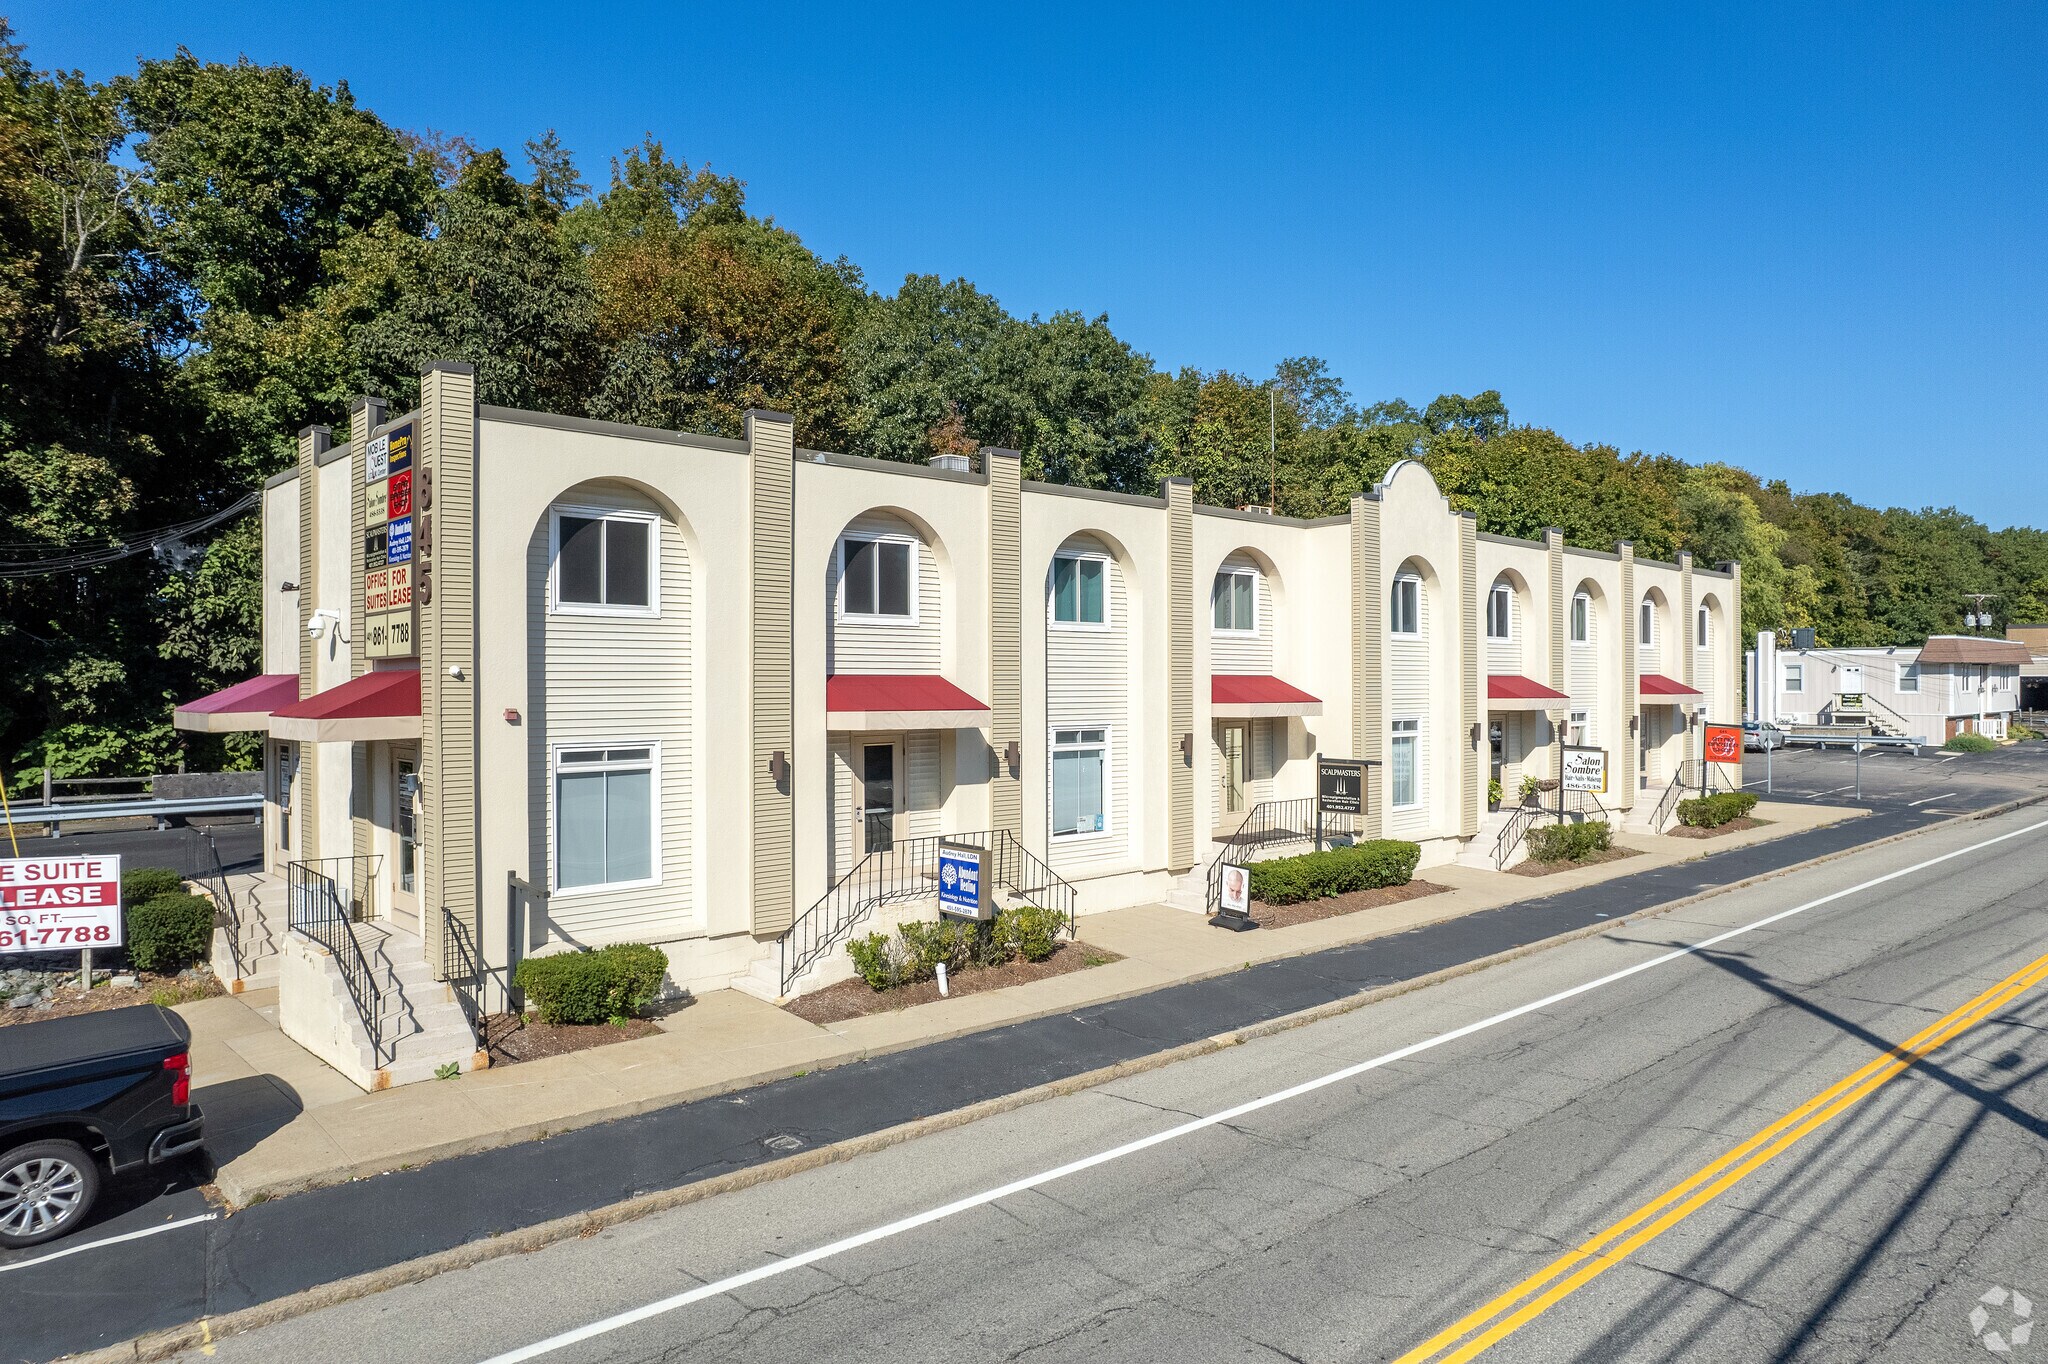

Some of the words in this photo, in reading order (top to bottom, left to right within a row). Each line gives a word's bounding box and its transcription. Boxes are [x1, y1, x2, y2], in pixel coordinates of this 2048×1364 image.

[368, 439, 386, 456] MOBILE
[367, 572, 387, 590] OFFICE
[392, 568, 407, 586] FOR
[367, 592, 387, 610] SUITES
[388, 587, 411, 606] LEASE
[391, 622, 409, 644] 7788
[1575, 753, 1600, 766] Salon
[1321, 768, 1361, 777] SCALPMASTERS
[942, 849, 957, 858] Audrey
[24, 862, 102, 881] SUITE
[958, 865, 978, 881] Abundant
[0, 886, 102, 907] LEASE
[963, 896, 978, 904] Nutrition
[6, 915, 35, 926] SQ.
[40, 913, 62, 924] FT.
